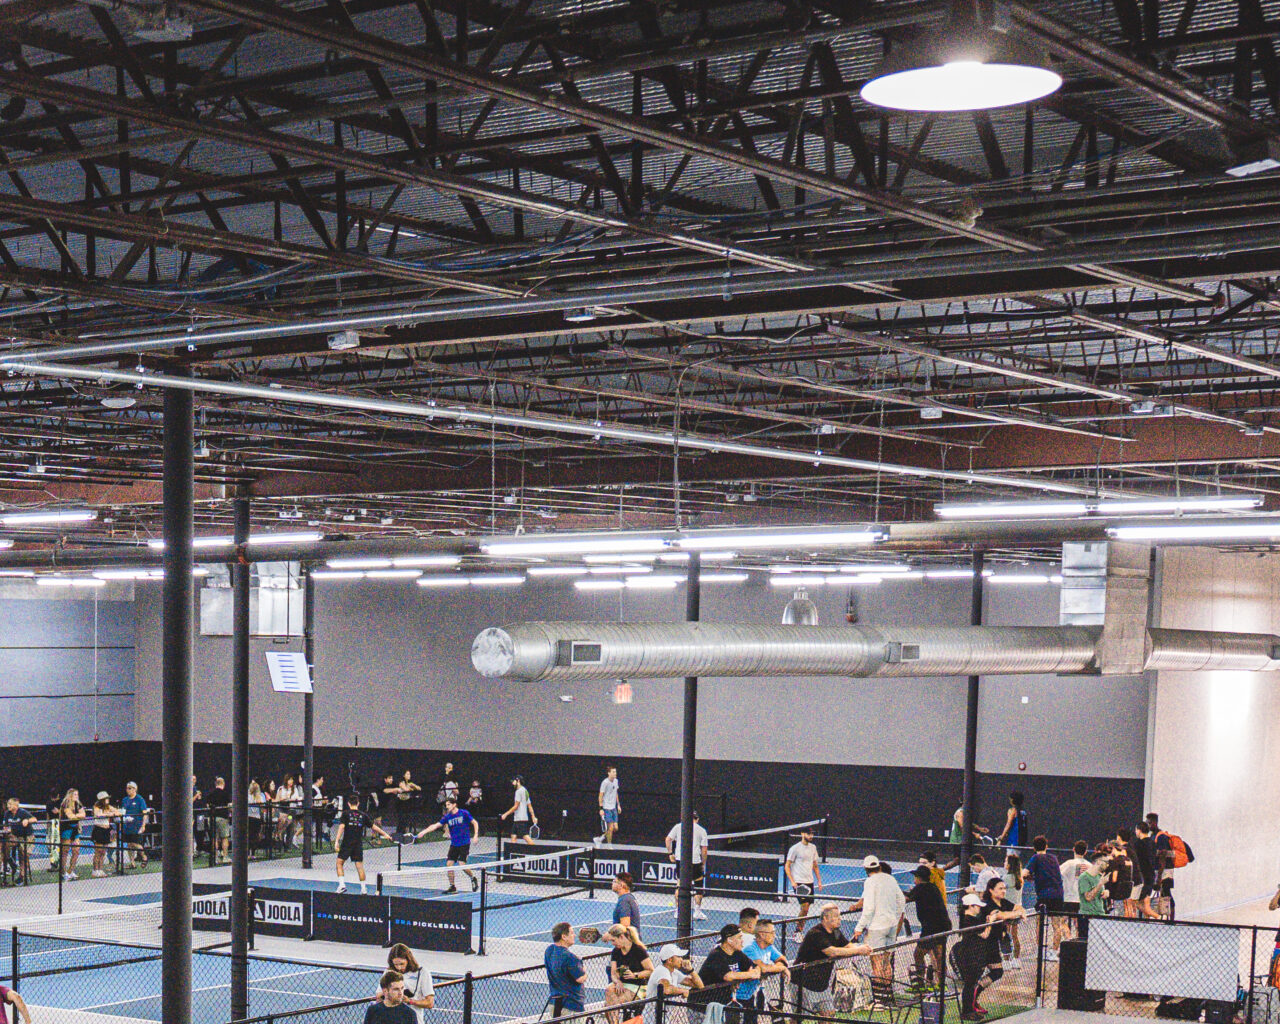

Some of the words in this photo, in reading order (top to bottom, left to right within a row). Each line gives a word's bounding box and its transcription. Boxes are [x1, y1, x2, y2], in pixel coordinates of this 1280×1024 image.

[725, 874, 774, 882] PICKLEBALL
[267, 904, 301, 921] JOOLA
[333, 914, 384, 923] PICKLEBALL
[412, 920, 466, 930] PICKLEBALL
